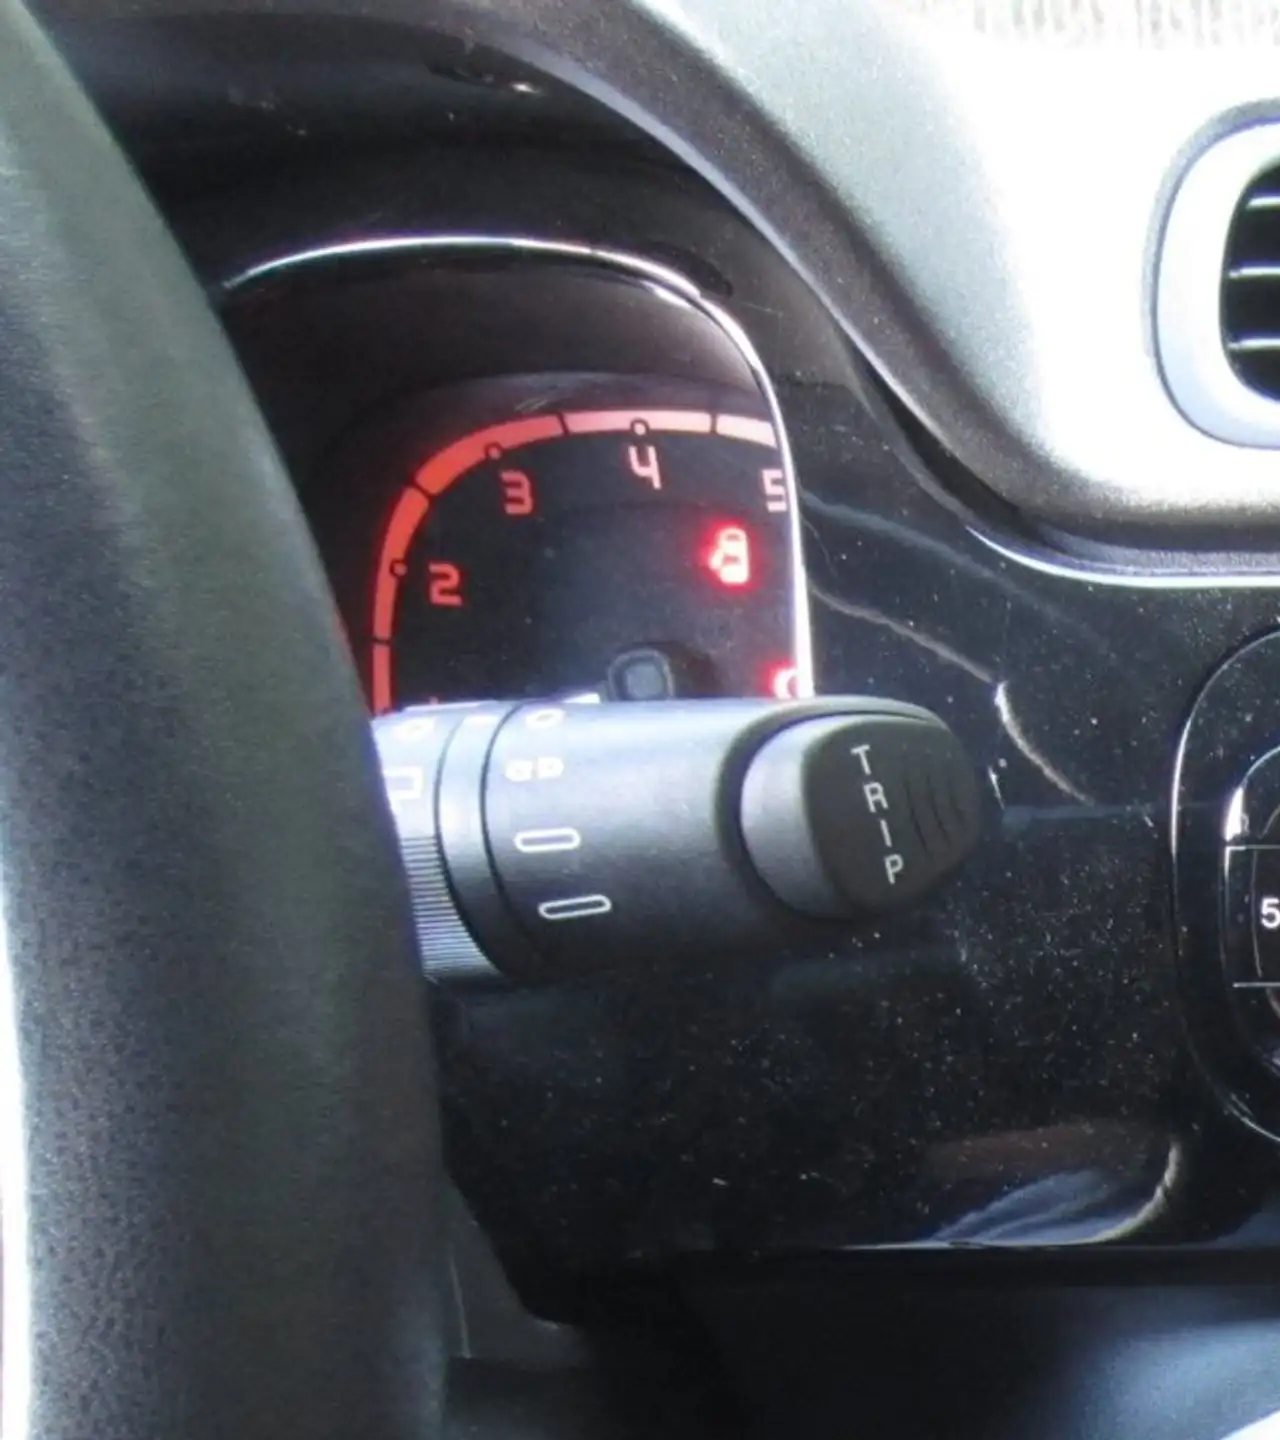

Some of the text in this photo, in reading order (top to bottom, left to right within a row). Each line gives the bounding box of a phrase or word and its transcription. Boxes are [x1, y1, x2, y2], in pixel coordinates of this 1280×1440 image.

[629, 445, 662, 490] 4
[500, 470, 534, 516] 3
[761, 468, 788, 513] 5
[428, 563, 463, 607] 2
[851, 744, 905, 885] TRIP
